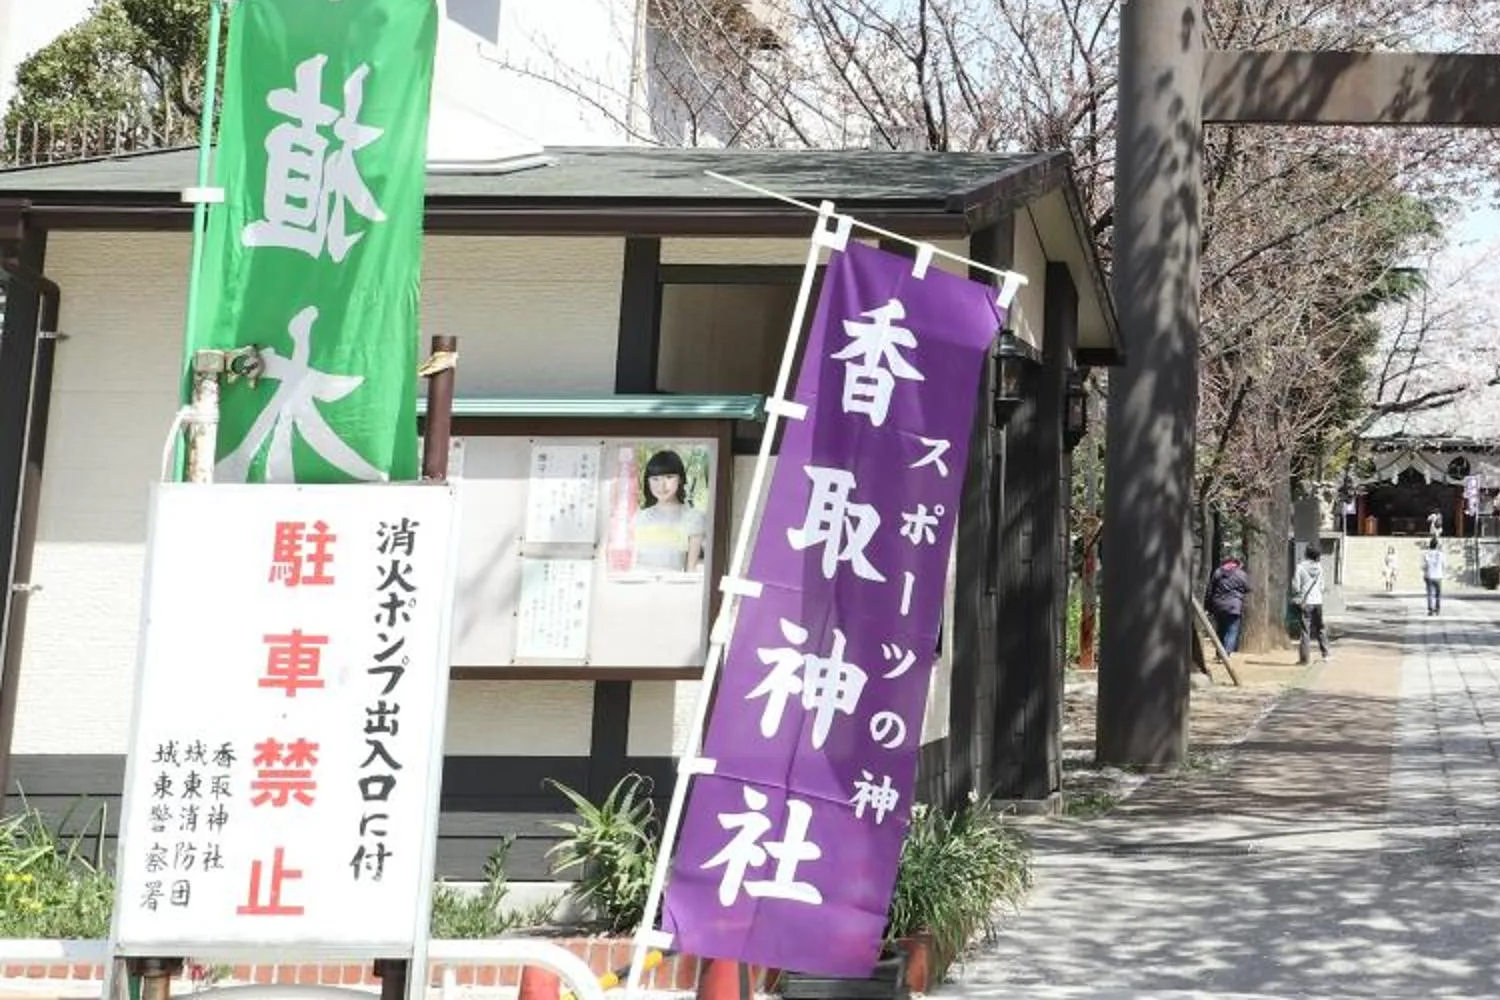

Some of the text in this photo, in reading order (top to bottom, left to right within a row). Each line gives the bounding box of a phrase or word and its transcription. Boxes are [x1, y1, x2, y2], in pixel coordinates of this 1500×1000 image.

[236, 520, 337, 915] 駐車禁止
[349, 517, 420, 882] 消火ポンプ出入口に付
[700, 298, 925, 907] 香取神社
[850, 436, 952, 825] スポーツの神
[140, 739, 181, 911] 城東警察署
[170, 739, 208, 907] 城東消防団
[203, 742, 237, 872] 香取神社
